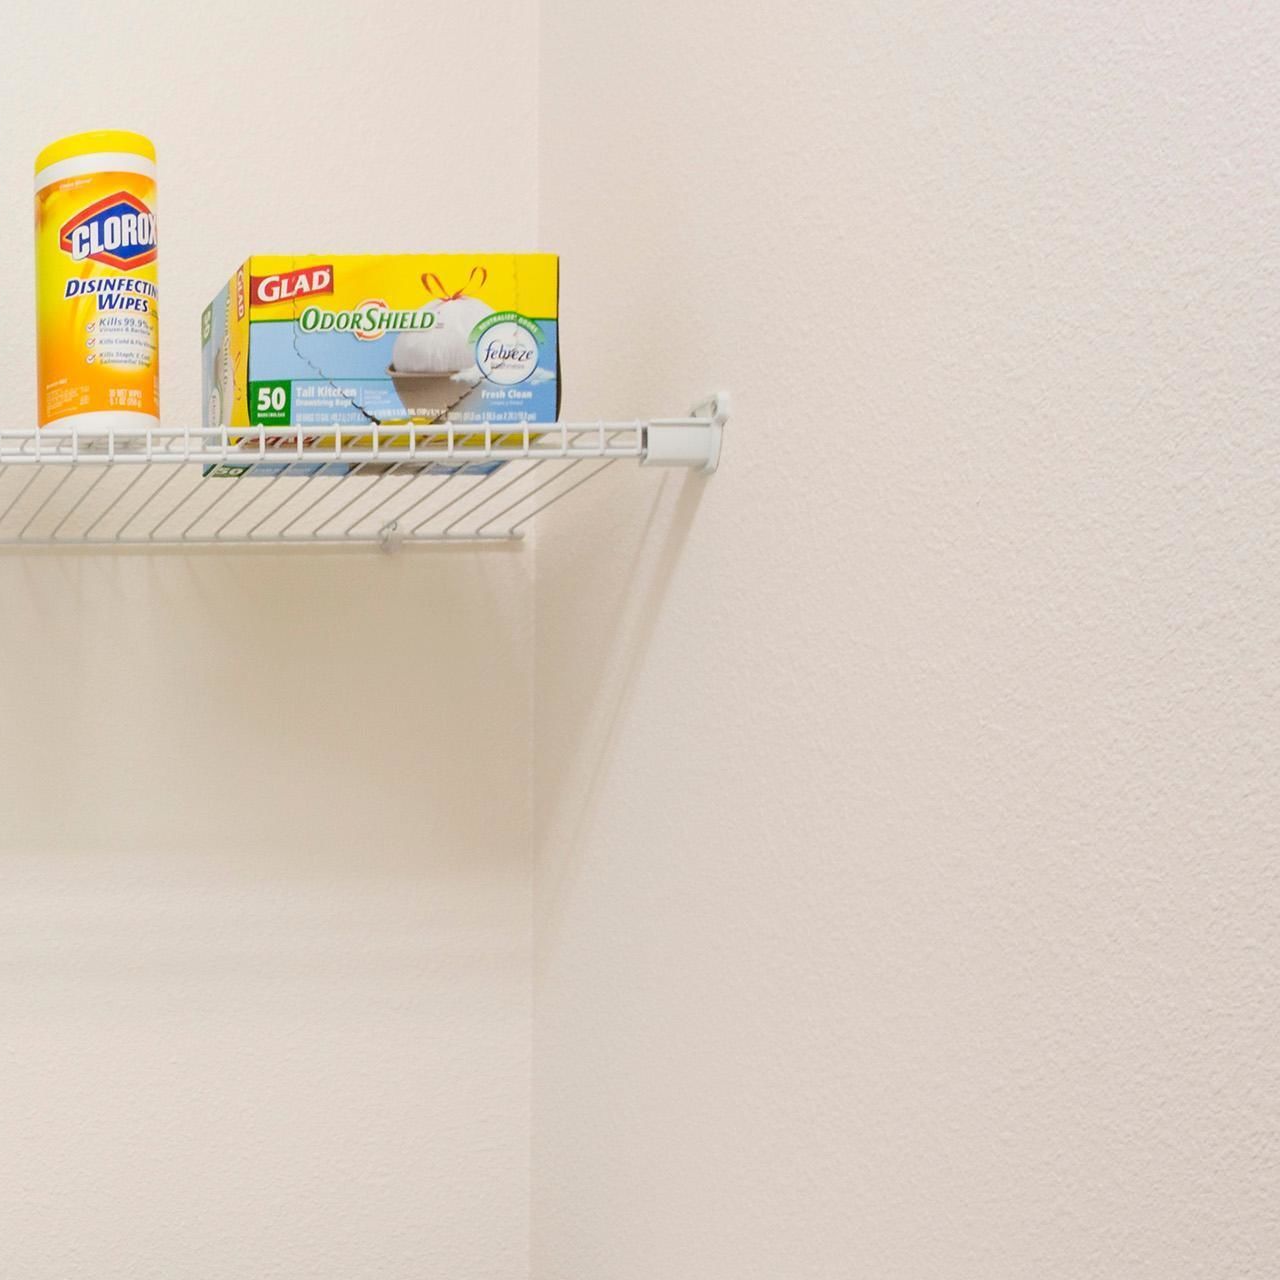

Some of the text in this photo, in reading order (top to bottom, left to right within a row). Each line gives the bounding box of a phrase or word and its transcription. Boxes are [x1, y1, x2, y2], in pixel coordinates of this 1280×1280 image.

[72, 213, 157, 261] CLOROX
[65, 279, 158, 299] DISINFECTIN
[258, 270, 330, 302] GLAD
[98, 294, 149, 313] WIPES
[99, 318, 122, 327] Kills
[257, 386, 287, 412] 50
[296, 387, 314, 398] Tall
[317, 386, 357, 398] Kitchen
[481, 390, 533, 399] Fresh Clean
